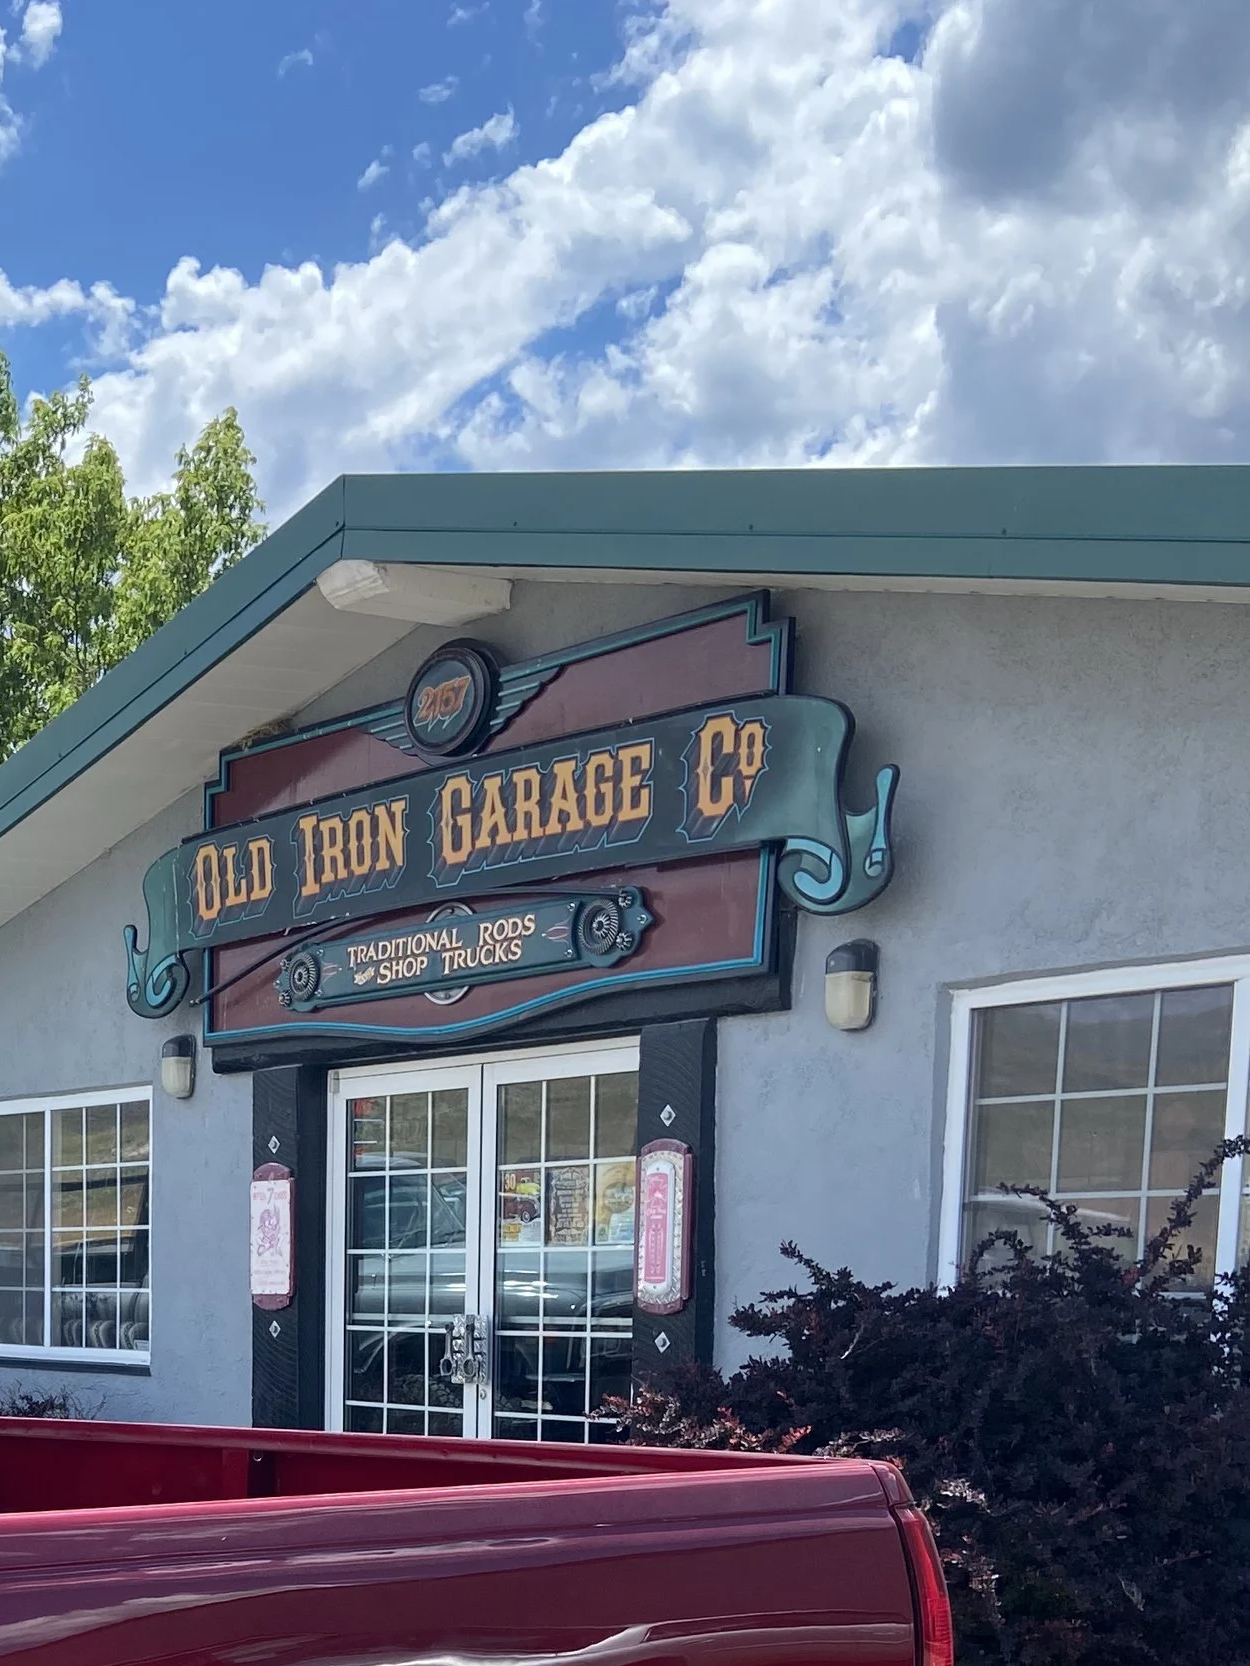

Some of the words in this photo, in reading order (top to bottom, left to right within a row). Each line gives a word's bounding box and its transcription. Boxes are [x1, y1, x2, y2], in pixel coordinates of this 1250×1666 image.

[194, 836, 274, 923] OLD
[298, 798, 407, 898] IRON
[440, 741, 653, 866] GARAGE
[347, 927, 464, 968] TRADITIONAL
[477, 914, 537, 947] RODS
[376, 956, 429, 985] SHOP
[441, 939, 523, 976] TRUCKS
